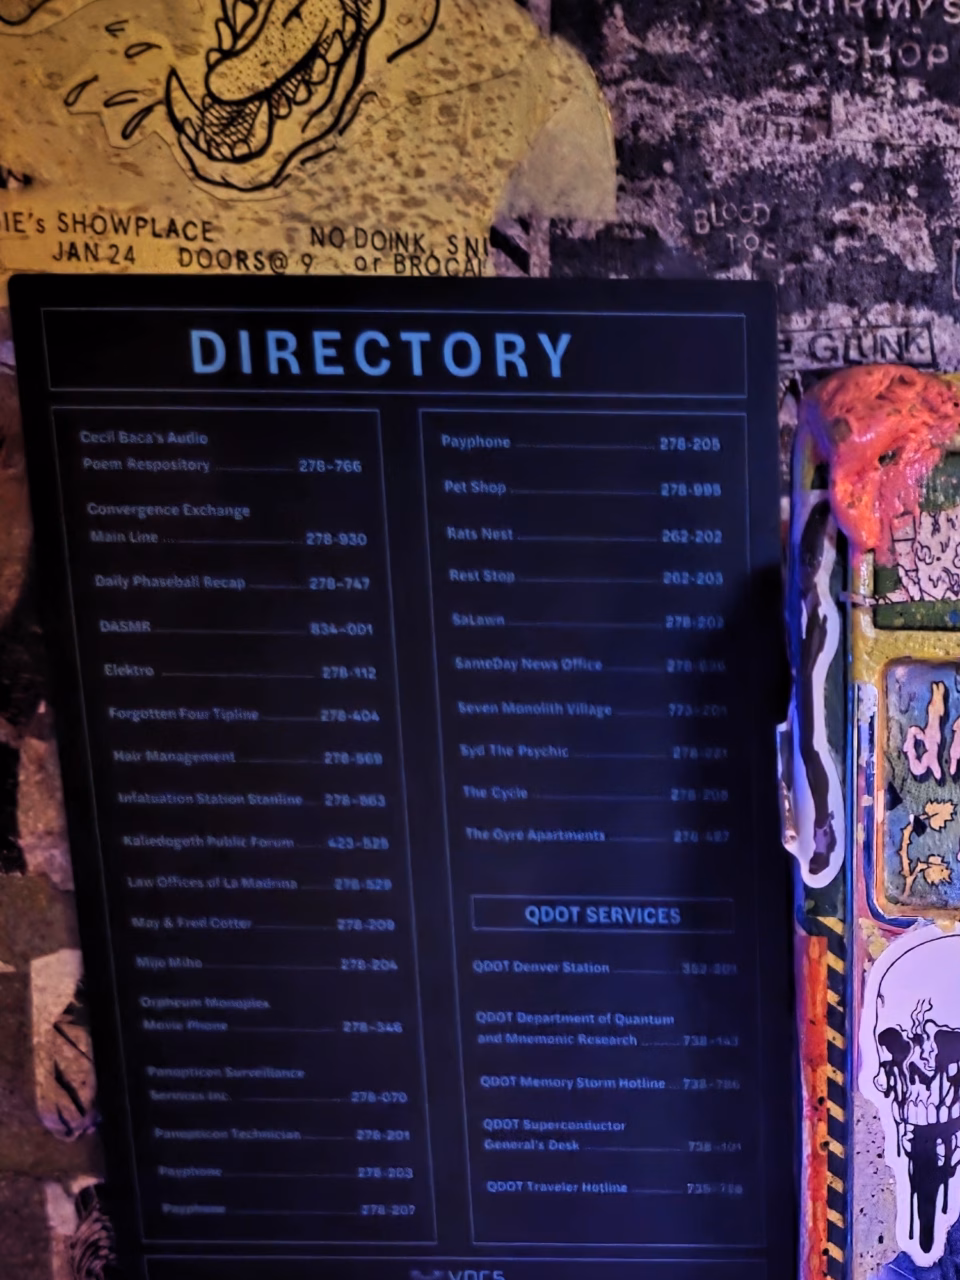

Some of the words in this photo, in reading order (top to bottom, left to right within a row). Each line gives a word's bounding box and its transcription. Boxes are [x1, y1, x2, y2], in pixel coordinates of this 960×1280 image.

[837, 35, 949, 68] SHOP
[57, 212, 216, 242] SHOWPLACE
[310, 226, 345, 249] NO
[52, 241, 99, 262] JAN
[109, 243, 136, 265] 24
[354, 256, 381, 272] or
[189, 329, 572, 379] DIRECTORY
[167, 431, 209, 445] Audio
[441, 434, 512, 450] Payphone
[83, 457, 122, 471] Poem
[299, 458, 363, 473] 278-766
[444, 480, 467, 493] Pet
[470, 480, 507, 497] Shop
[86, 503, 180, 520] Convergence
[182, 503, 251, 521] Exchange
[90, 530, 126, 543] Main
[129, 531, 159, 543] Line
[306, 532, 368, 546] 278-930
[446, 526, 478, 541] Rats
[481, 527, 514, 541] Nest
[95, 575, 129, 590] Daily
[204, 576, 246, 591] Recap
[309, 577, 370, 591] 278-747
[449, 569, 481, 582] Rest
[482, 569, 516, 585] Stop
[104, 664, 155, 677] Elektro
[454, 657, 518, 673] SameDay
[521, 658, 558, 671] News
[561, 658, 603, 671] Office
[322, 667, 377, 680] 278-112
[108, 706, 177, 723] Forgotten
[457, 701, 499, 714] Seven
[502, 701, 563, 714] Monolith
[320, 709, 380, 722] 278-404
[146, 751, 236, 766] Management
[489, 744, 514, 757] The
[517, 744, 569, 760] Psychic
[462, 785, 488, 799] The
[491, 786, 528, 802] Cycle
[465, 827, 489, 841] The
[527, 828, 606, 842] Apartments
[524, 905, 580, 925] QDOT
[586, 906, 682, 925] SERVICES
[472, 960, 510, 974] QDOT
[513, 960, 561, 974] Denver
[562, 961, 610, 974] Station
[476, 1011, 513, 1024] QDOT
[516, 1012, 594, 1027] Department
[599, 1012, 612, 1025] of
[615, 1013, 675, 1026] Quantum
[478, 1032, 502, 1044] and
[505, 1033, 573, 1045] Mnemonic
[578, 1033, 638, 1046] Research
[480, 1075, 517, 1089] QDOT
[520, 1076, 573, 1091] Memory
[576, 1076, 616, 1089] Storm
[619, 1076, 666, 1090] Hotline
[483, 1118, 519, 1132] QDOT
[484, 1138, 545, 1151] General's
[549, 1139, 580, 1152] Desk
[486, 1180, 523, 1194] QDOT
[527, 1181, 578, 1194] Traveler
[582, 1181, 628, 1195] Hotline
